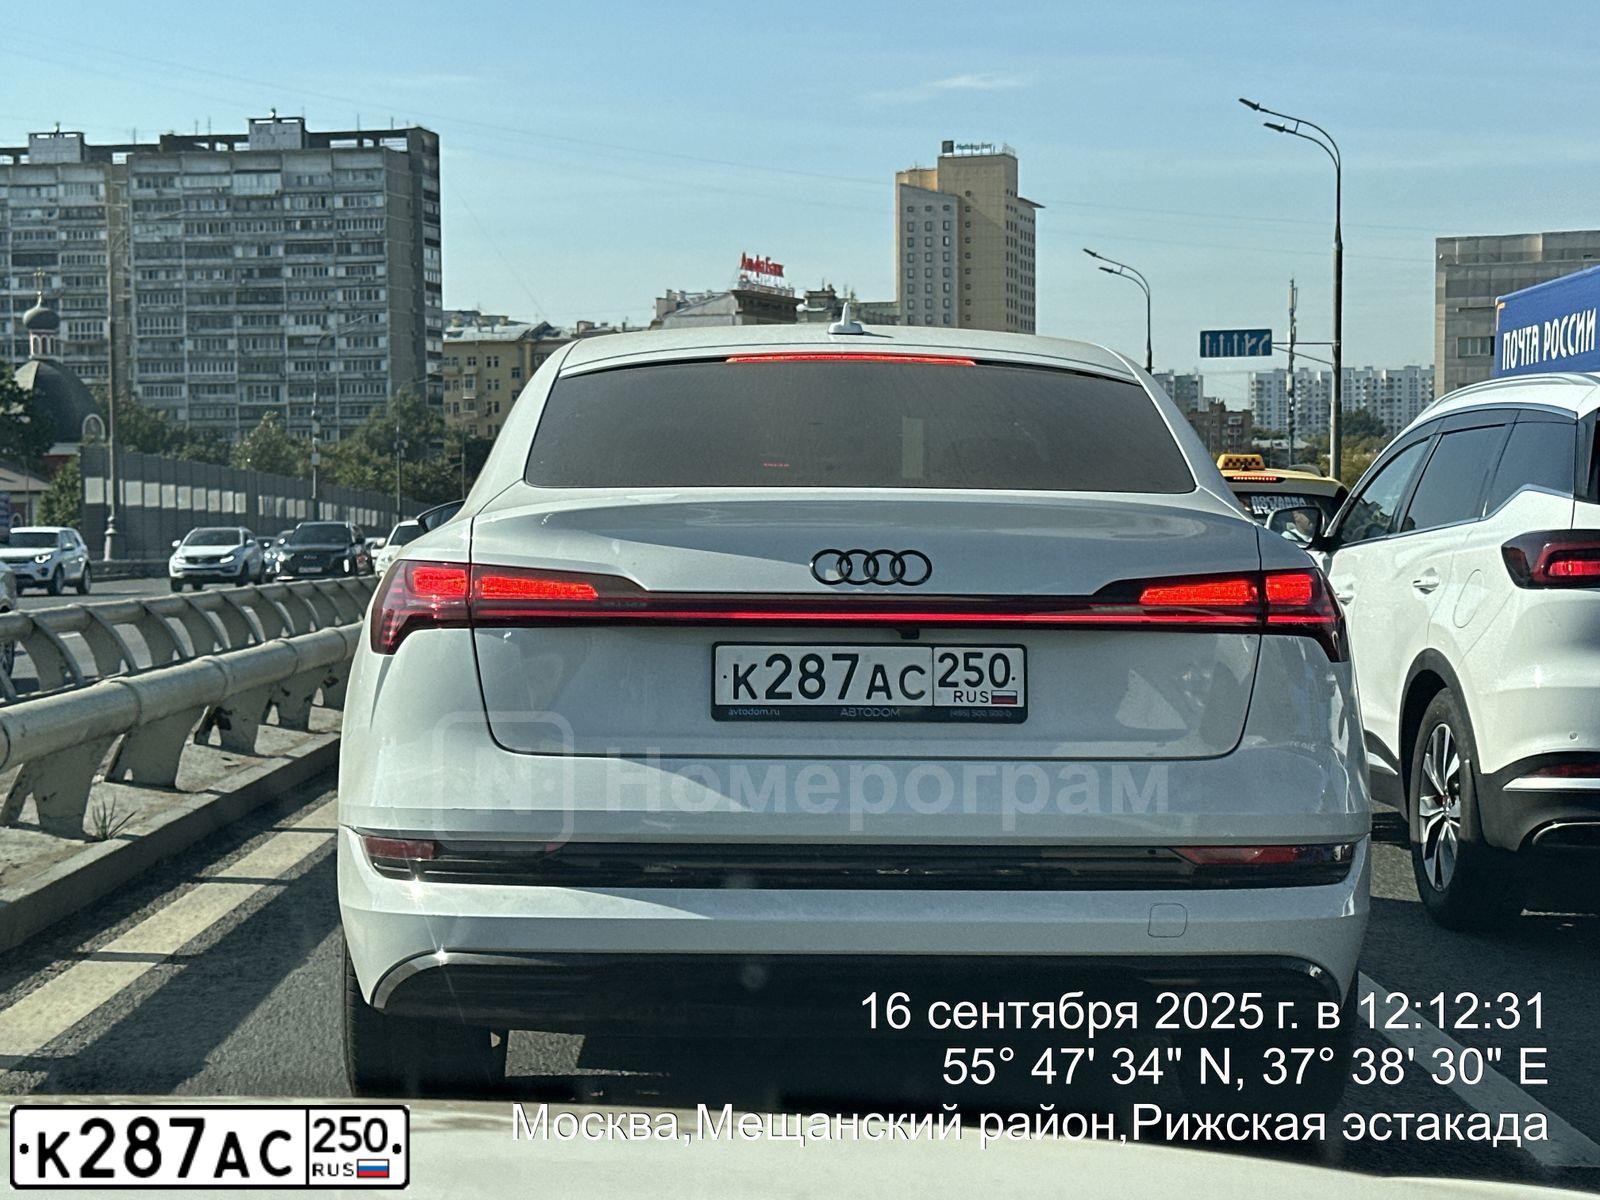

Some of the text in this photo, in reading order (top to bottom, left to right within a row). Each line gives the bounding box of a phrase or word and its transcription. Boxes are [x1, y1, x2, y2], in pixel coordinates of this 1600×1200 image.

[1502, 307, 1597, 371] ПОЧТА РОССИИ
[937, 652, 1011, 688] 250
[953, 690, 990, 704] RUS
